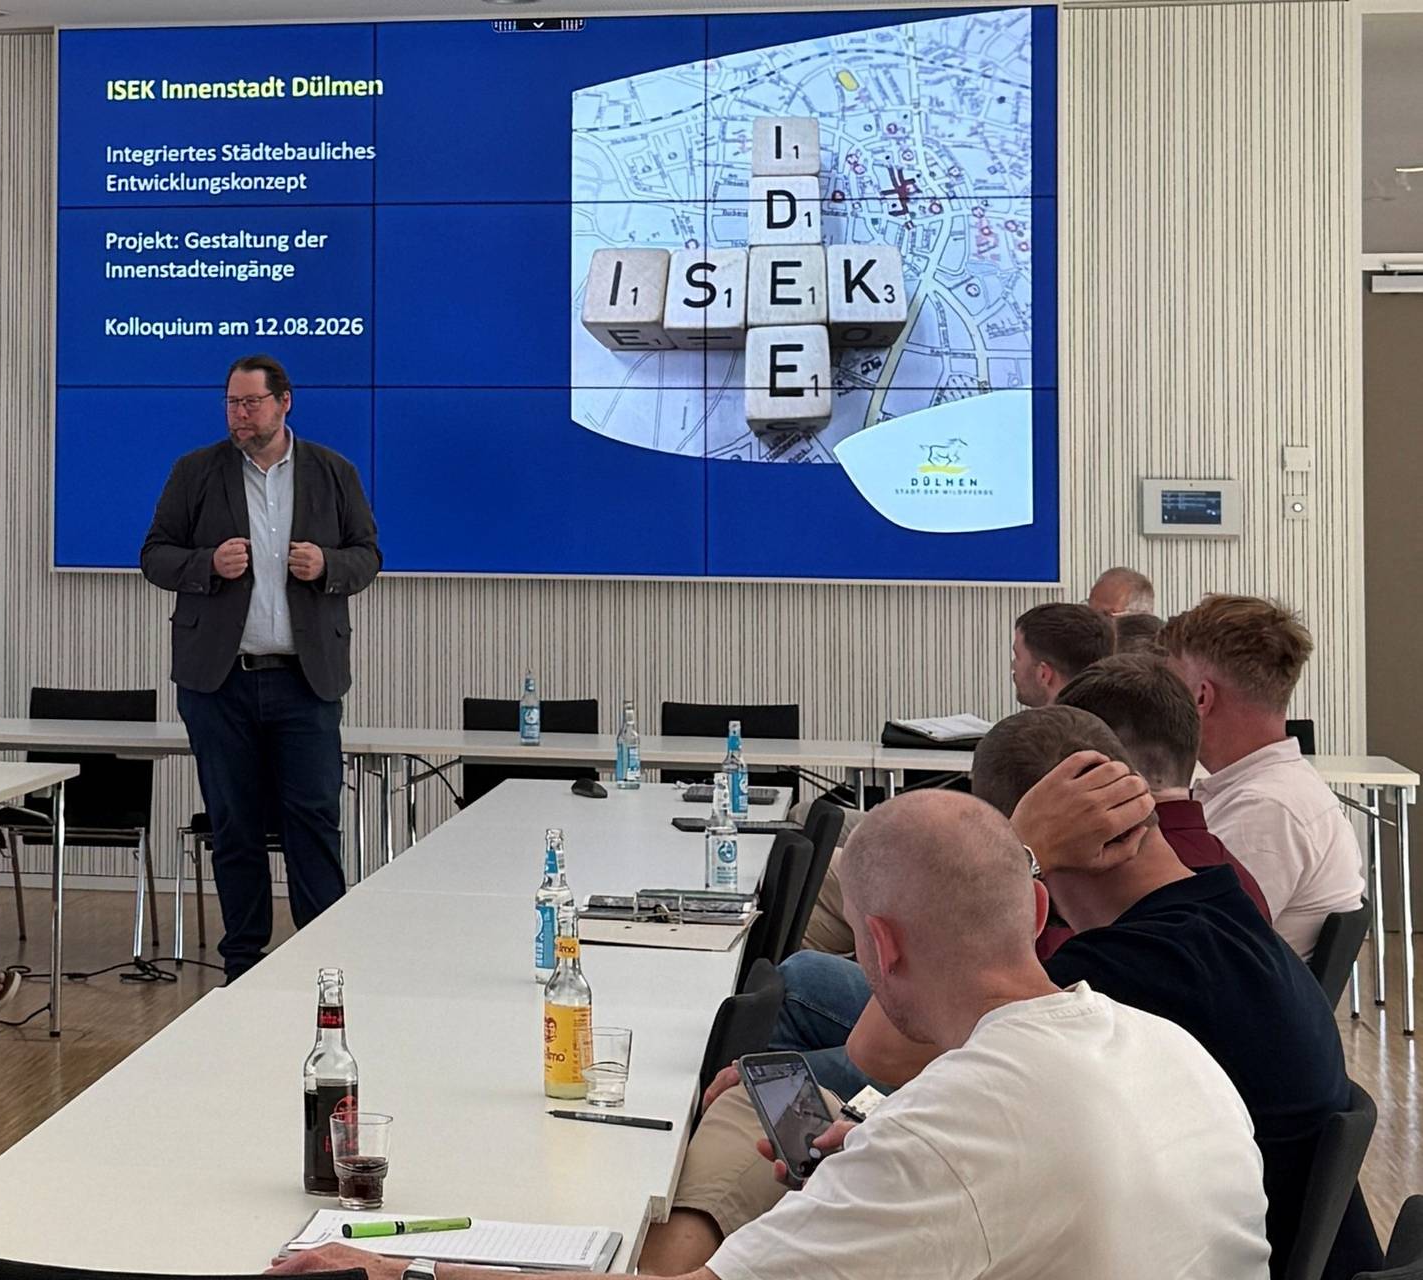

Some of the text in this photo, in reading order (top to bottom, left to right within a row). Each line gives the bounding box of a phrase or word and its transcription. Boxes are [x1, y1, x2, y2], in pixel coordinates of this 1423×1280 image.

[107, 75, 384, 101] ISEK Innenstadt Dülmen
[106, 142, 376, 166] Integriertes Städtebauliches
[106, 172, 307, 195] Entwicklungskonzept
[105, 229, 328, 253] Projekt: Gestaltung der
[105, 260, 295, 281] Innenstadteingänge
[105, 317, 364, 340] Kolloquium am 12.08.2026
[910, 475, 979, 487] DÜLMEN
